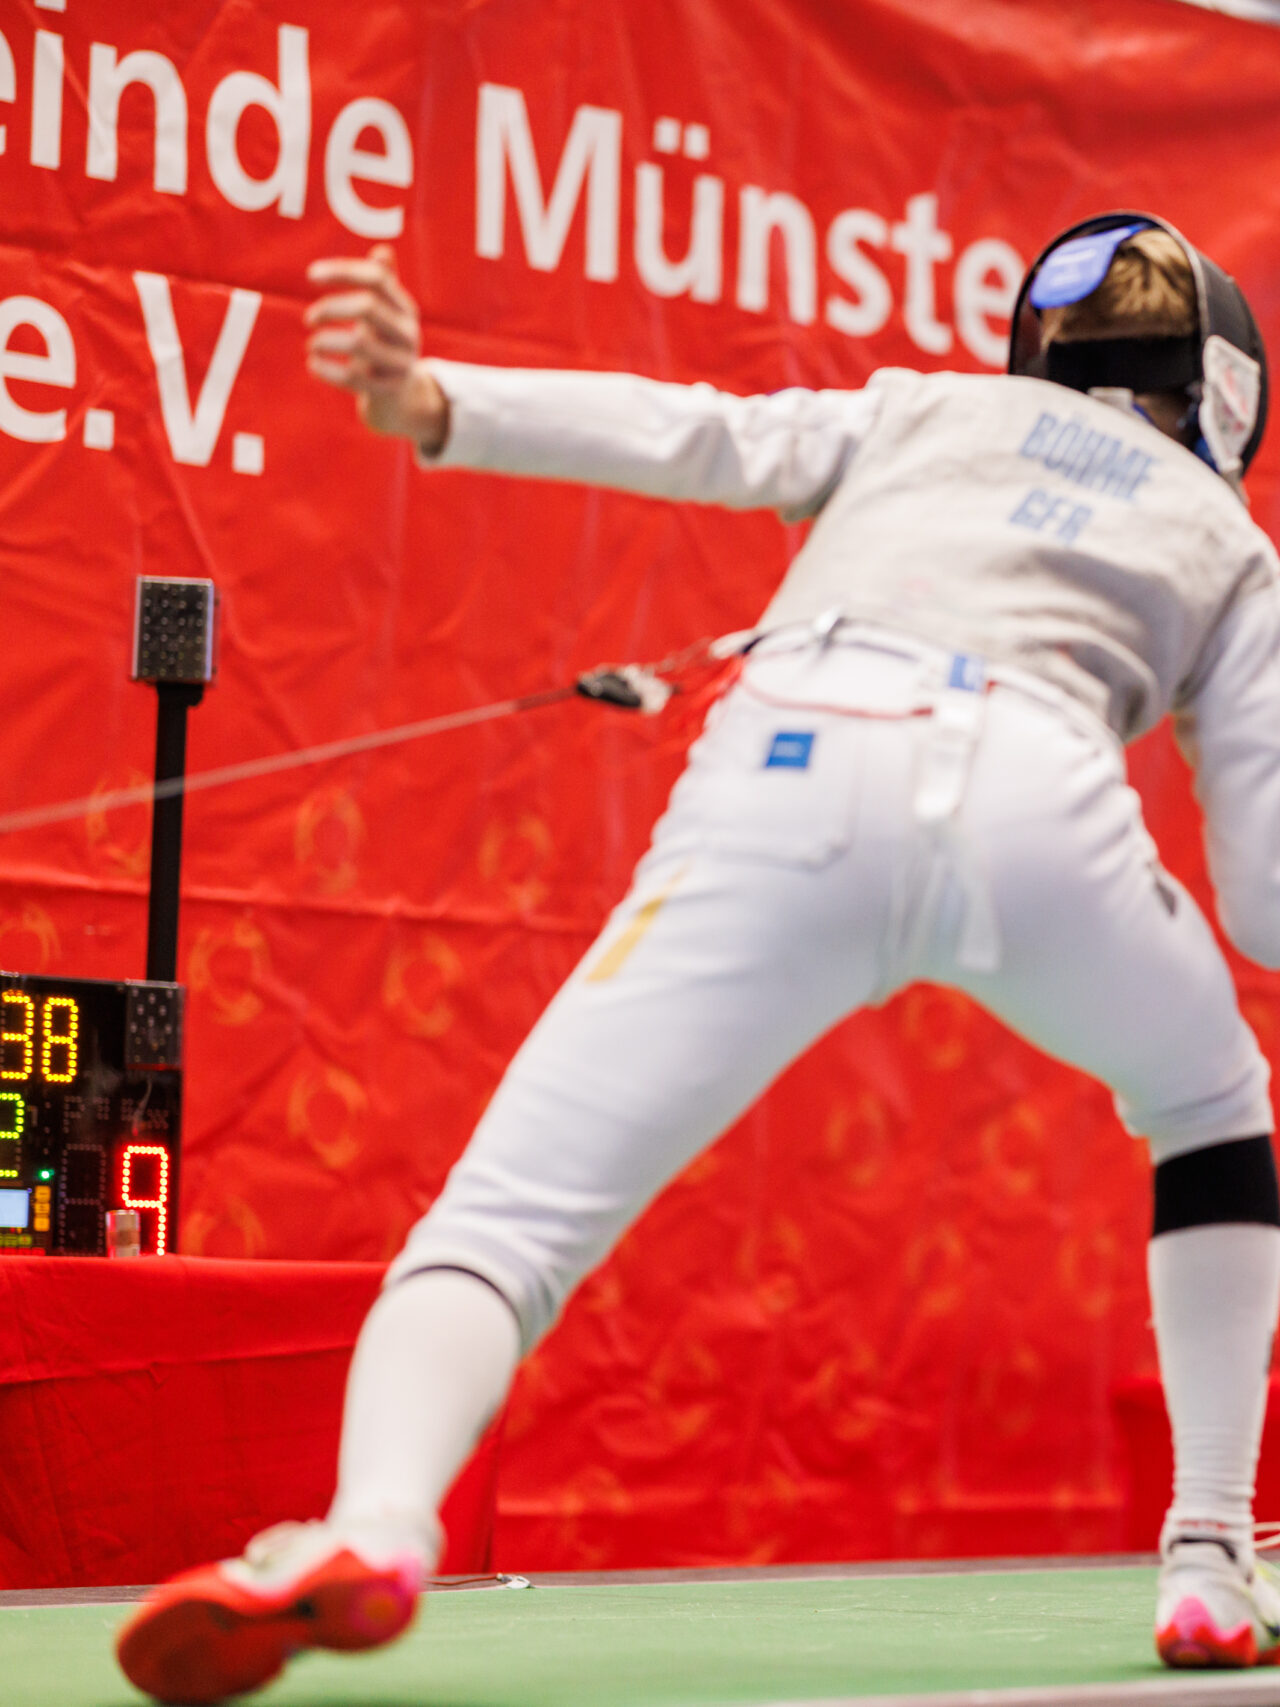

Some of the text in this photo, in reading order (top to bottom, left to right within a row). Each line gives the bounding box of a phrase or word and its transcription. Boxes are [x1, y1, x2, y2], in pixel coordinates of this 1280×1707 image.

[0, 0, 413, 240] inde
[0, 271, 264, 475] e.V.
[121, 1145, 169, 1257] 9
